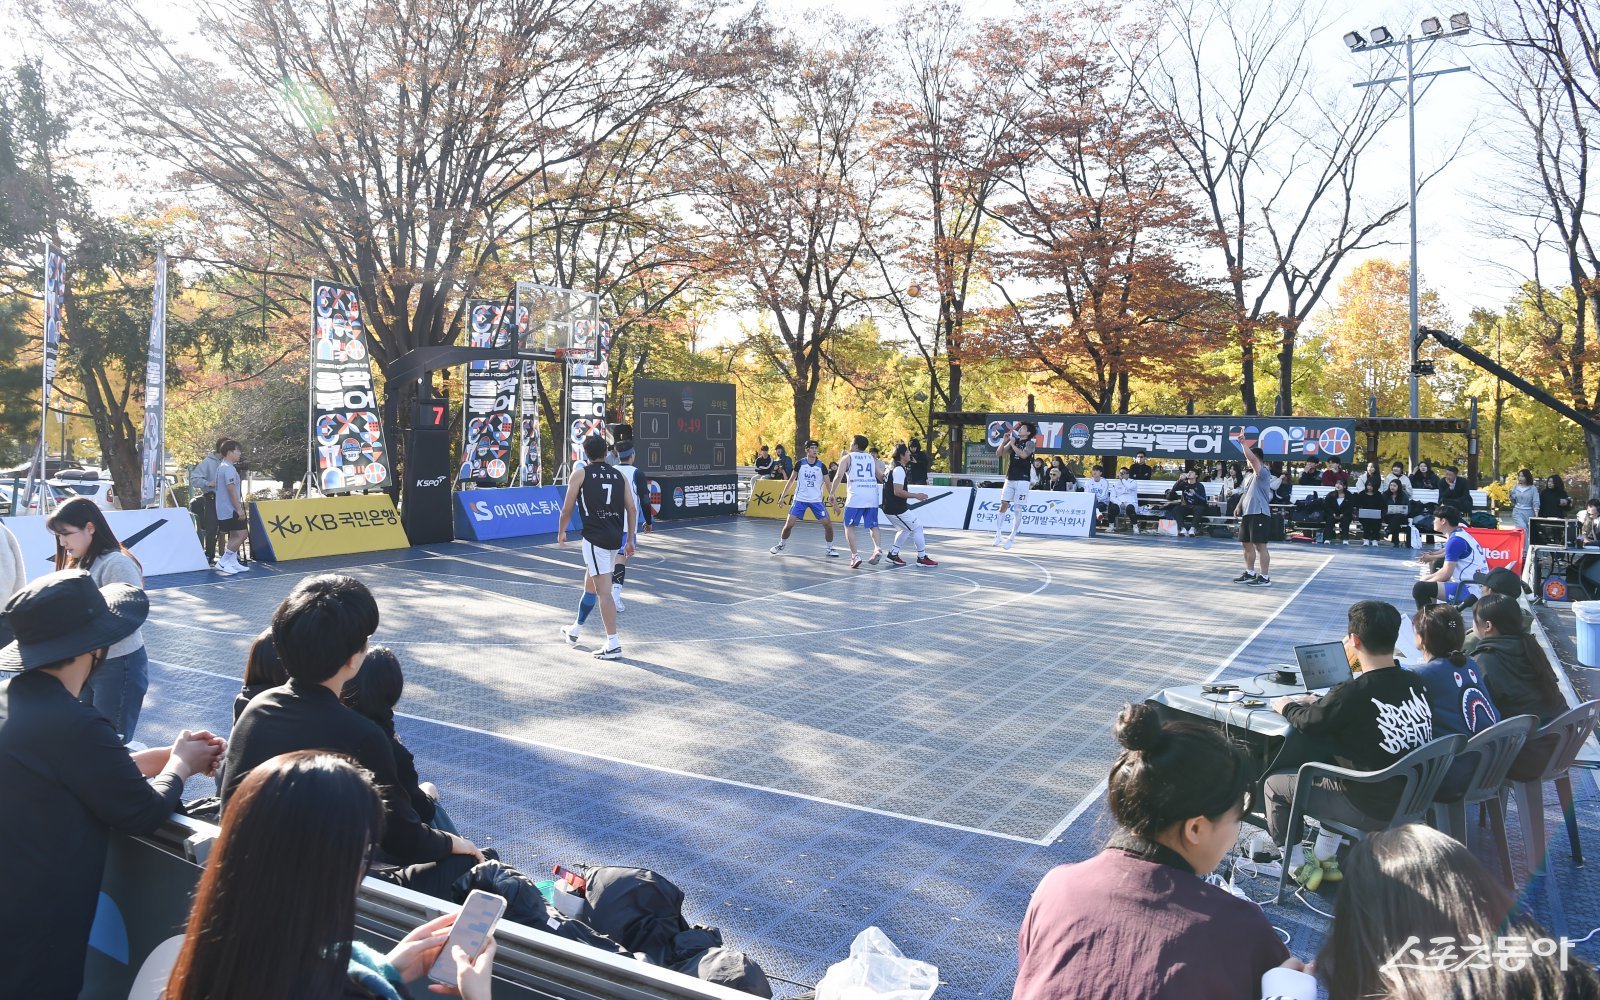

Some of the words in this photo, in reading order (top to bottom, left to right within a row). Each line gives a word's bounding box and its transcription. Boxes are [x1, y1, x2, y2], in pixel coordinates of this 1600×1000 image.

[433, 407, 444, 424] 7
[652, 418, 658, 433] 0
[677, 416, 702, 433] 9:49
[717, 419, 721, 435] 1
[1094, 423, 1138, 431] 2024
[1140, 424, 1199, 433] KOREA
[1092, 432, 1222, 453] 올팍투어
[856, 463, 873, 477] 24
[602, 484, 612, 504] 7
[685, 491, 735, 507] 올팍투어
[493, 501, 561, 519] 아이에스동서
